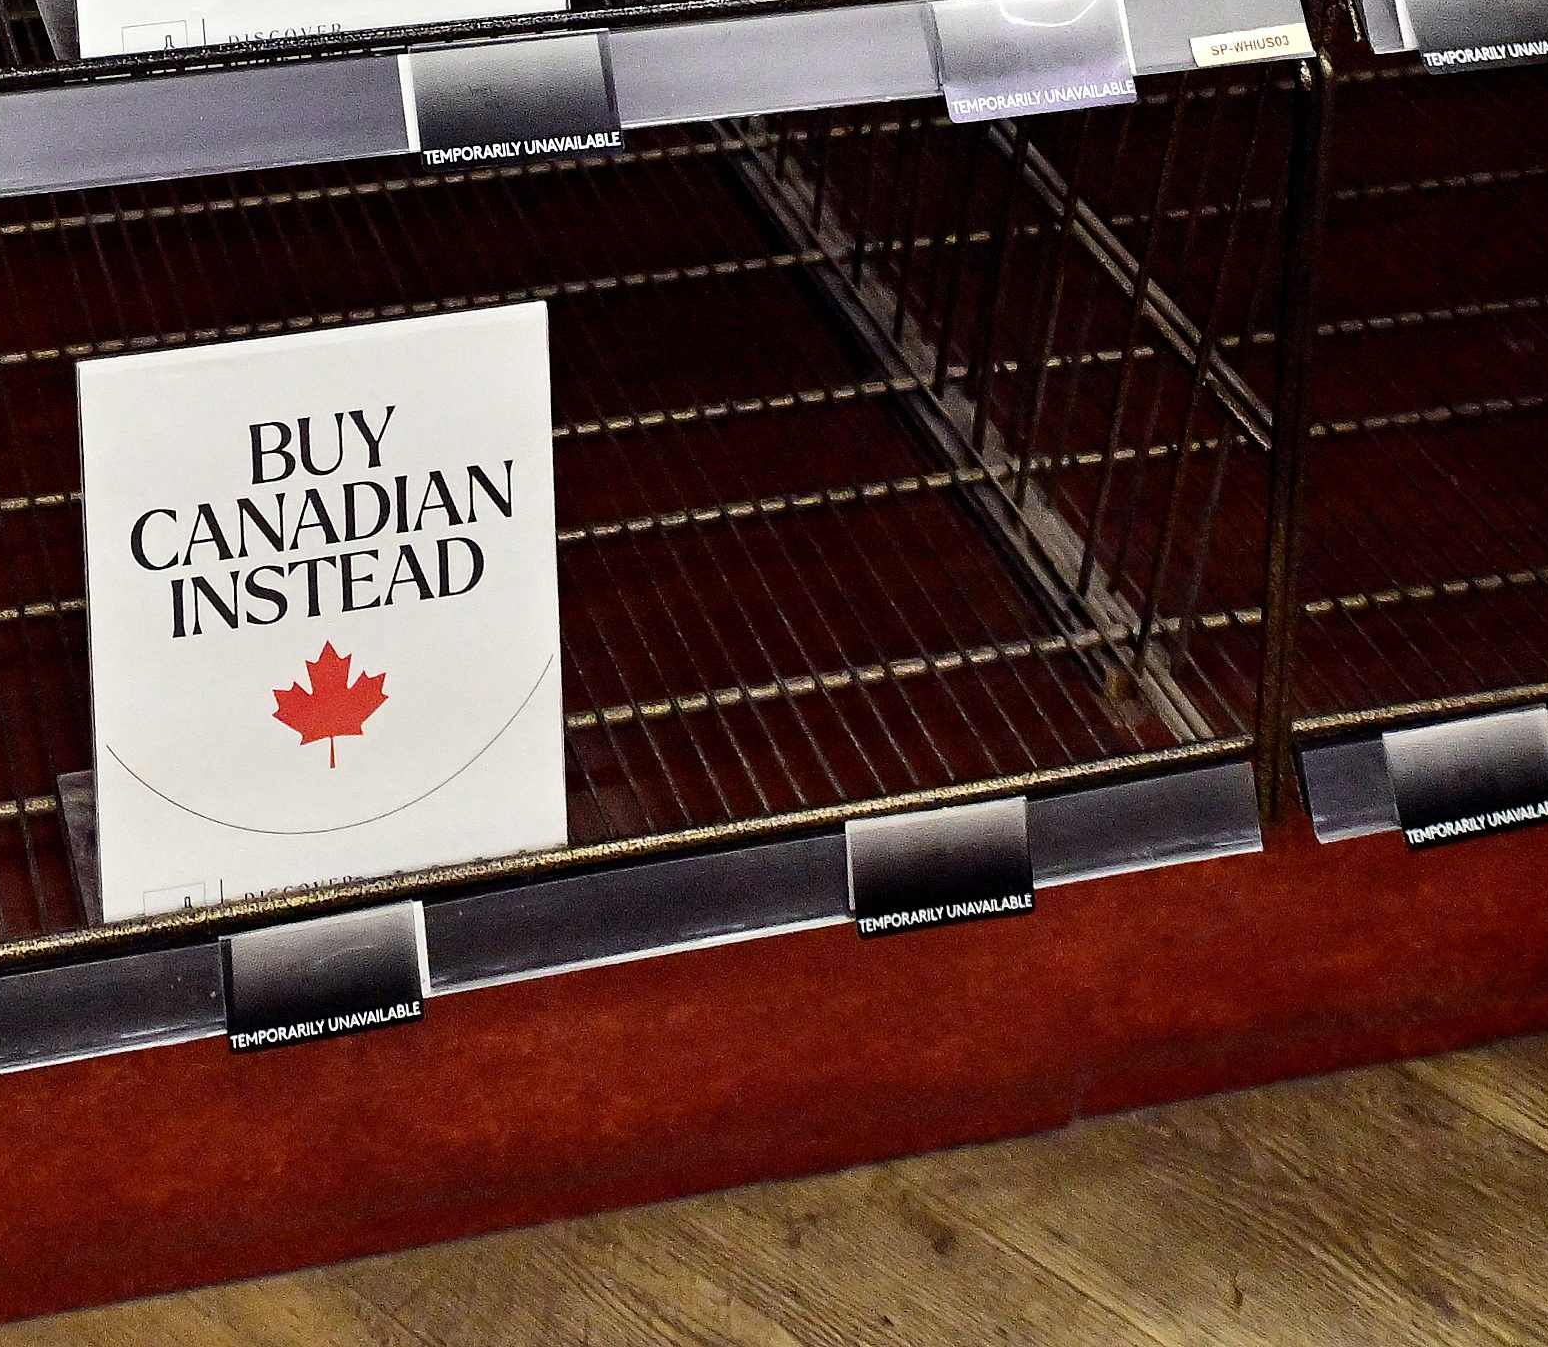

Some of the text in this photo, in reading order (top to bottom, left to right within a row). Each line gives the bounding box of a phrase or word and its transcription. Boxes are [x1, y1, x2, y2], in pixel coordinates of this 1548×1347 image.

[1209, 35, 1291, 60] SP-WHIUS03
[1424, 44, 1506, 67] TEMPORARILY
[951, 79, 1137, 115] TEMPORARILY UNAVAILABLE
[424, 131, 621, 165] TEMPORARILY UNAVAILABLE
[248, 406, 396, 485] BUY
[130, 460, 514, 571] CANADIAN
[171, 537, 485, 638] INSTEAD
[1406, 813, 1485, 845] TEMPORARILY
[856, 892, 1034, 933] TEMPORARILY UNAVAILABLE
[229, 999, 423, 1049] TEMPORARILY UNAVAILABLE
